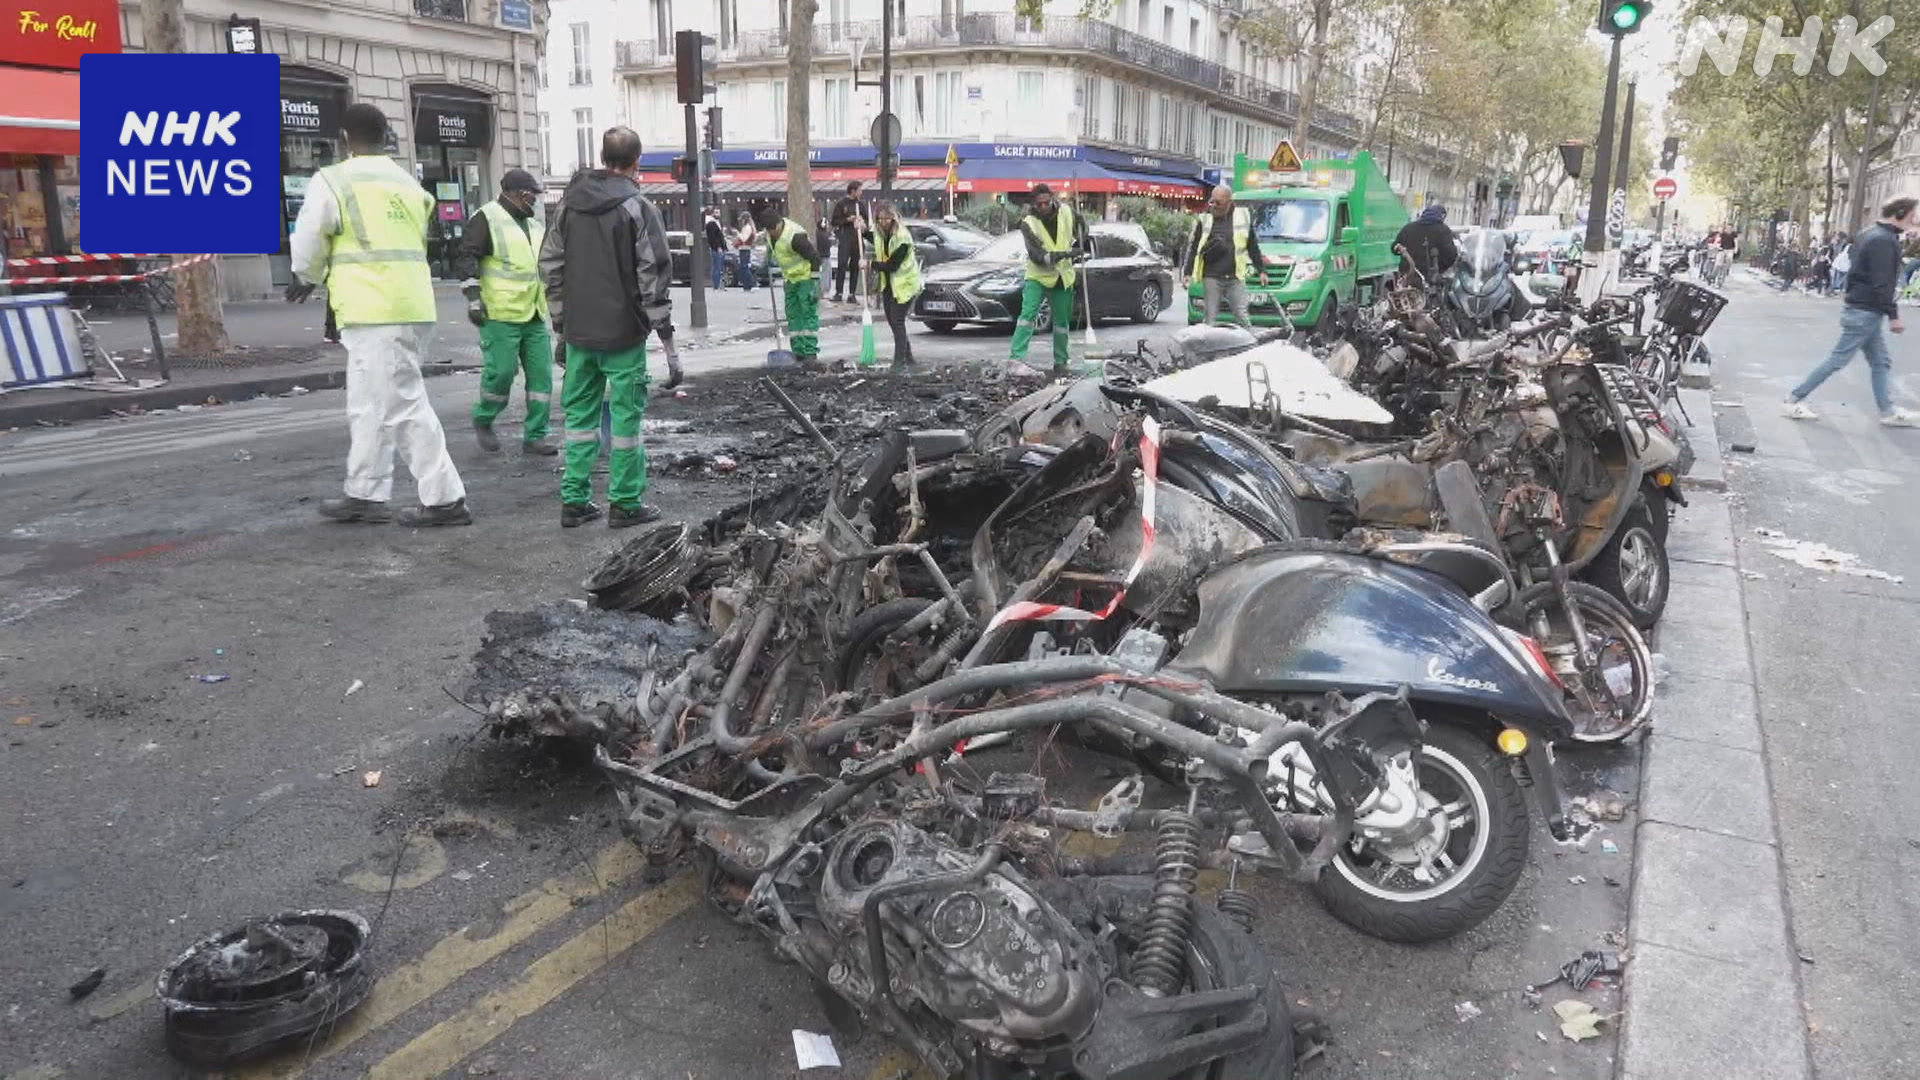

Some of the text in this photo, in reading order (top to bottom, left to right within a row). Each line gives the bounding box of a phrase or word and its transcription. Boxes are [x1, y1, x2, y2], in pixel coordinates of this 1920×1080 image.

[19, 10, 97, 42] For Real!
[280, 99, 319, 114] Fortis
[282, 114, 320, 127] immo
[438, 114, 466, 127] Fortis
[438, 126, 467, 138] immo
[754, 149, 779, 160] SACRÉ
[994, 145, 1025, 157] SACRÉ
[1027, 146, 1072, 158] FRENCHY
[1424, 656, 1503, 694] Vespa
